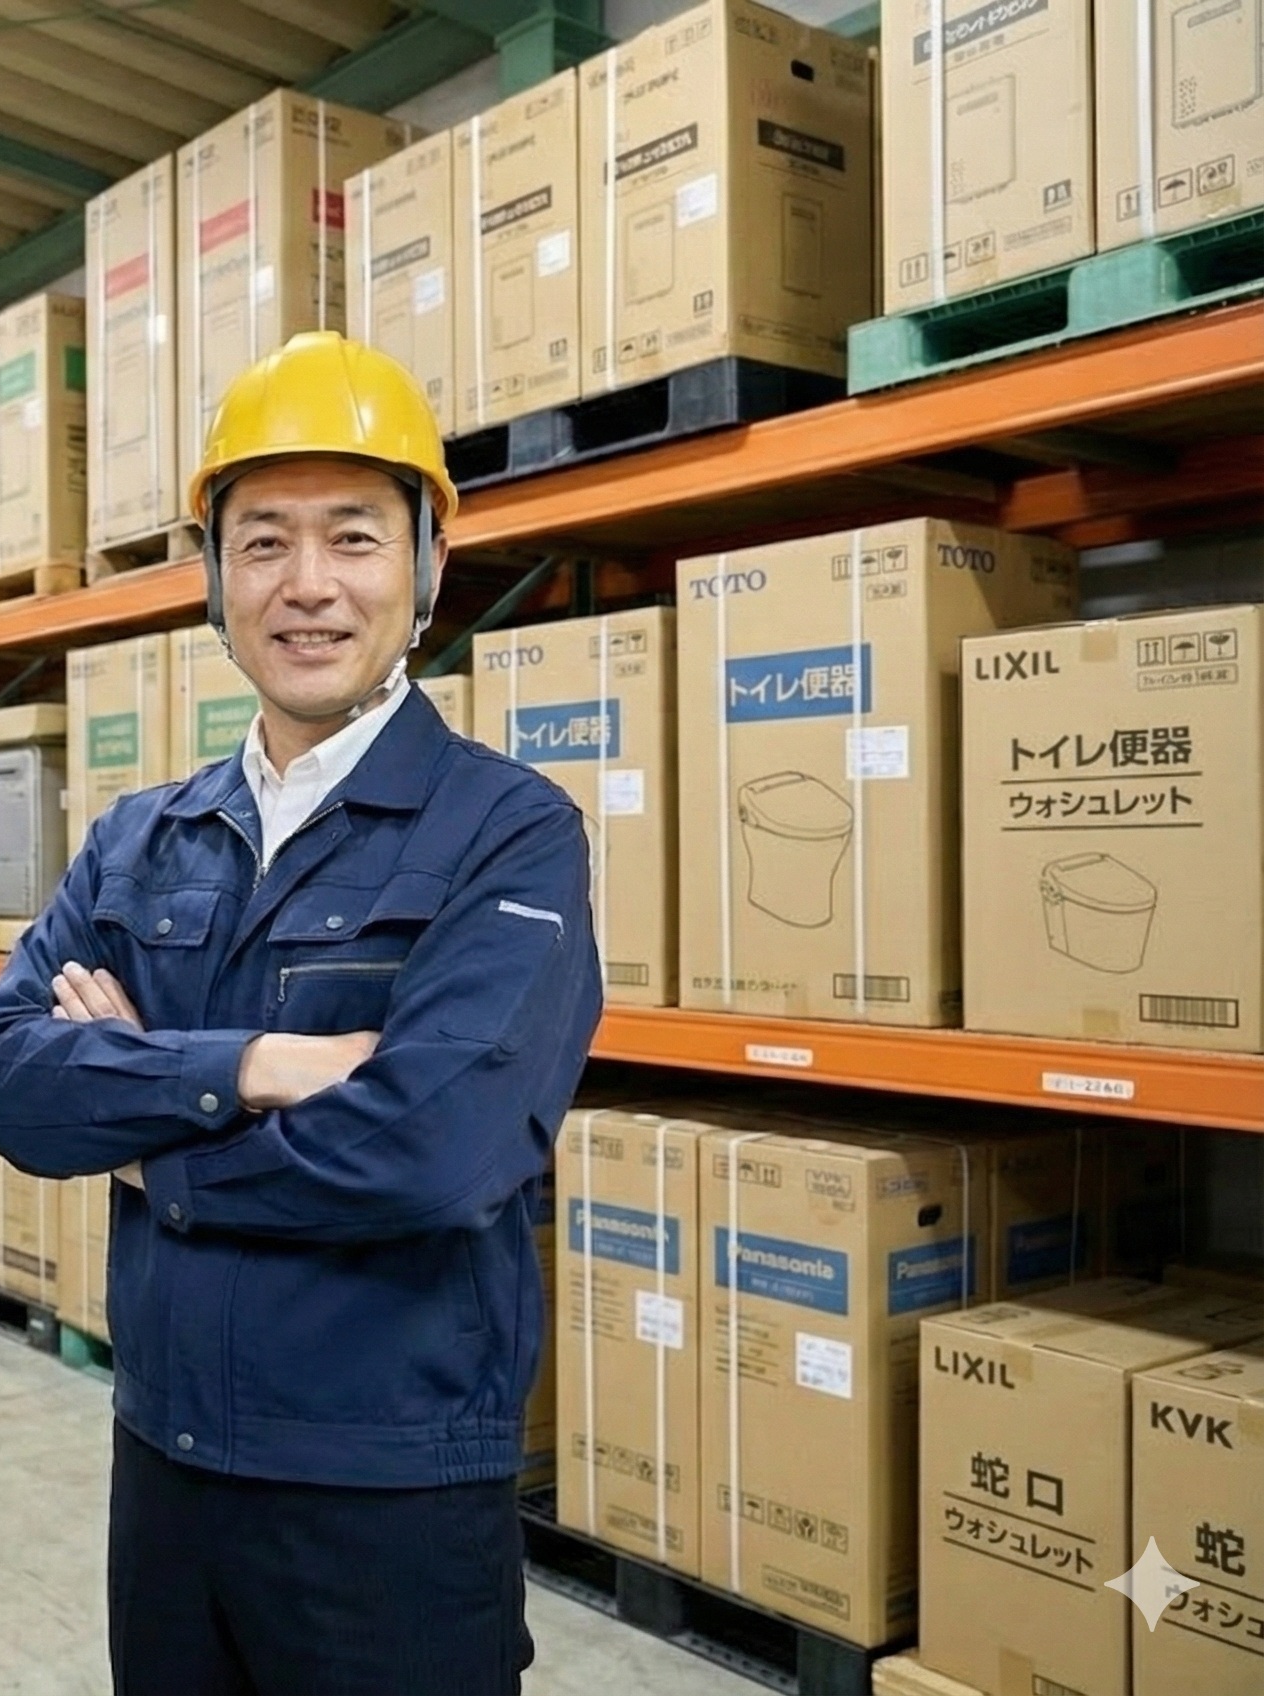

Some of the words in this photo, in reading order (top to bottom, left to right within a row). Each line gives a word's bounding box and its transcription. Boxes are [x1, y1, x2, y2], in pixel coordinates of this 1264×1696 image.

[938, 544, 996, 573] TOTO
[690, 570, 767, 599] TOTO
[484, 645, 544, 670] TOTO
[975, 650, 1060, 681] LIXIL
[730, 664, 856, 707] トイレ便器
[1011, 726, 1192, 771] トイレ便器
[1009, 785, 1193, 819] ウォシュレット
[934, 1346, 1016, 1389] LIXIL
[1151, 1402, 1233, 1450] KVK
[944, 1507, 1095, 1574] ウォシュレット
